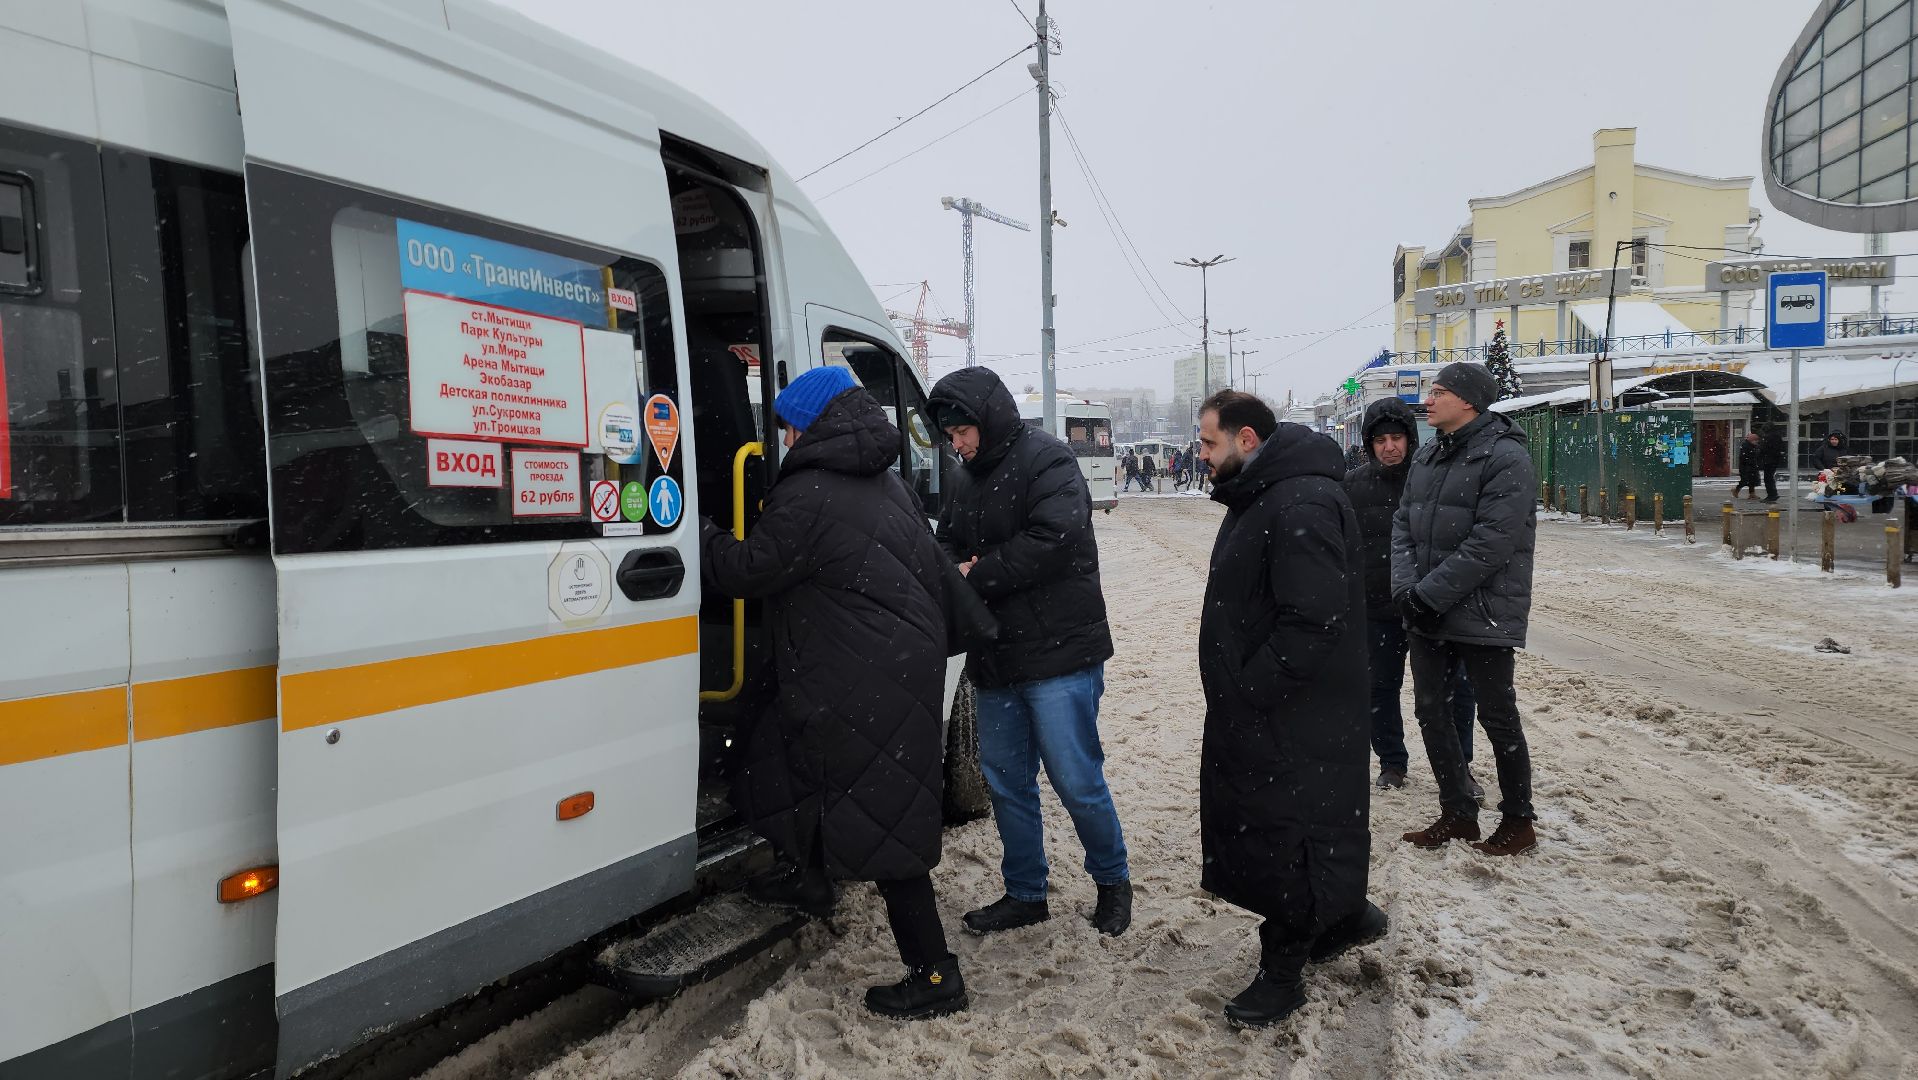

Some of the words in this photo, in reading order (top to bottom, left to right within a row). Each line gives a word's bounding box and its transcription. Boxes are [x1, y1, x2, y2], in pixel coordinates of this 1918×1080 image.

[407, 239, 455, 273] ООО
[462, 254, 600, 305] «ТрансИнвест»
[1721, 265, 1761, 283] ООО
[1433, 287, 1465, 307] ЗАО
[1474, 282, 1509, 303] ТПК
[1520, 278, 1545, 298] СБ
[1555, 273, 1602, 297] ЩИТ
[611, 293, 634, 307] ВХОД
[471, 311, 532, 331] ст.Мытищи
[460, 321, 489, 339] Парк
[492, 327, 543, 347] Культуры
[481, 343, 527, 360] ул.Мира
[463, 354, 498, 370] Арена
[501, 359, 545, 377] Мытищи
[479, 372, 532, 393] Экобазар
[439, 383, 488, 399] Детская
[491, 391, 567, 409] поликлинника
[472, 404, 541, 421] ул.Сукромка
[473, 420, 541, 436] ул.Троицкая
[436, 452, 496, 477] ВХОД
[524, 461, 569, 470] СТОИМОСТЬ
[530, 473, 564, 482] ПРОЕЗДА
[520, 490, 536, 503] 62
[540, 490, 575, 505] рубля
